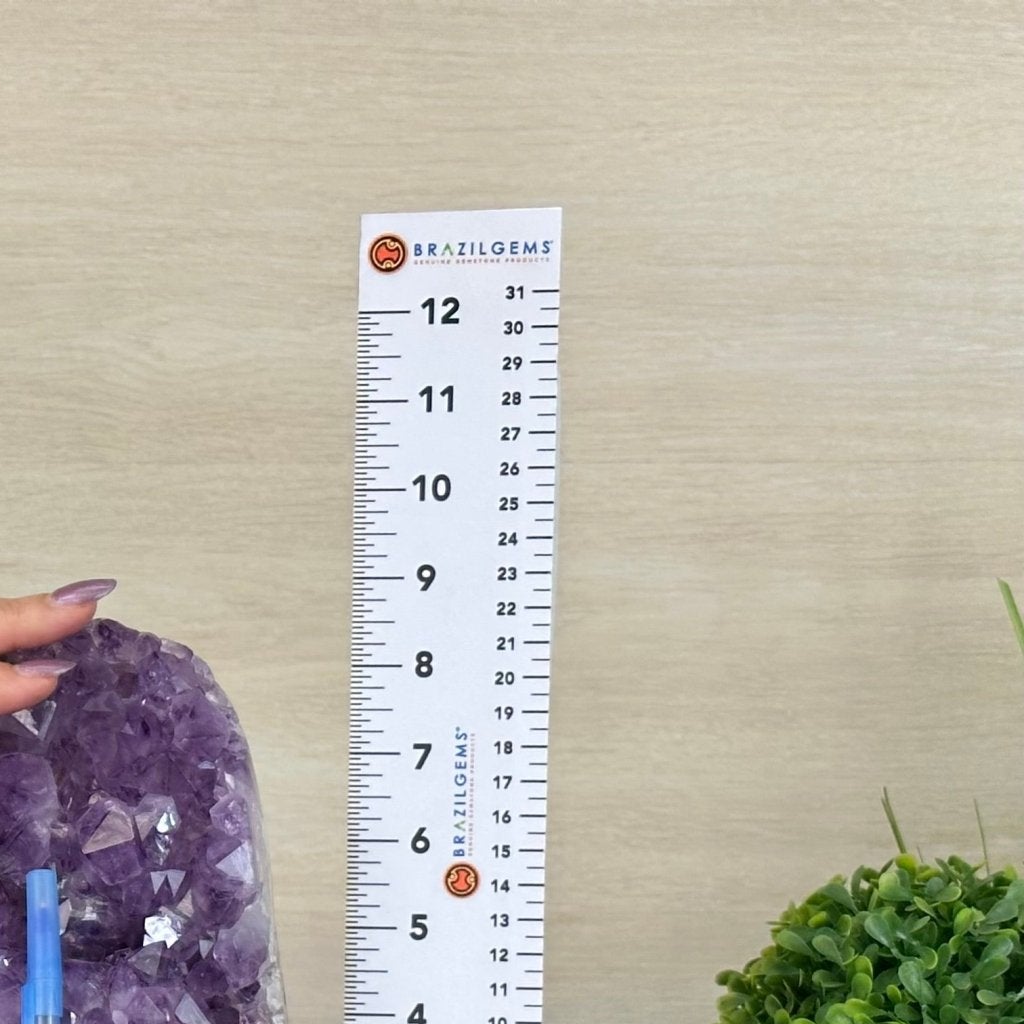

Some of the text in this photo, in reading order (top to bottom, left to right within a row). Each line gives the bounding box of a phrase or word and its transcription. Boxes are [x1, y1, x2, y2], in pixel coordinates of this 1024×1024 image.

[413, 240, 551, 257] BRAZILGEMS
[505, 285, 524, 300] 31
[420, 296, 460, 325] 12
[503, 320, 524, 336] 30
[502, 356, 523, 371] 29
[418, 385, 454, 413] 11
[501, 391, 522, 406] 28
[500, 426, 521, 441] 27
[499, 461, 520, 476] 26
[412, 473, 452, 502] 10
[498, 496, 519, 511] 25
[497, 531, 518, 546] 24
[416, 564, 437, 592] 9
[497, 566, 517, 581] 23
[496, 601, 517, 616] 22
[496, 636, 515, 651] 21
[414, 650, 434, 679] 8
[494, 671, 515, 686] 20
[494, 706, 514, 720] 19
[493, 740, 513, 755] 18
[412, 743, 433, 770] 7
[492, 775, 513, 790] 17
[453, 732, 468, 857] BRAZILGEMS
[492, 809, 512, 824] 16
[410, 826, 431, 854] 6
[491, 844, 511, 859] 15
[490, 879, 510, 893] 14
[409, 913, 429, 941] 5
[490, 913, 509, 928] 13
[489, 948, 509, 963] 12
[490, 982, 507, 997] 11
